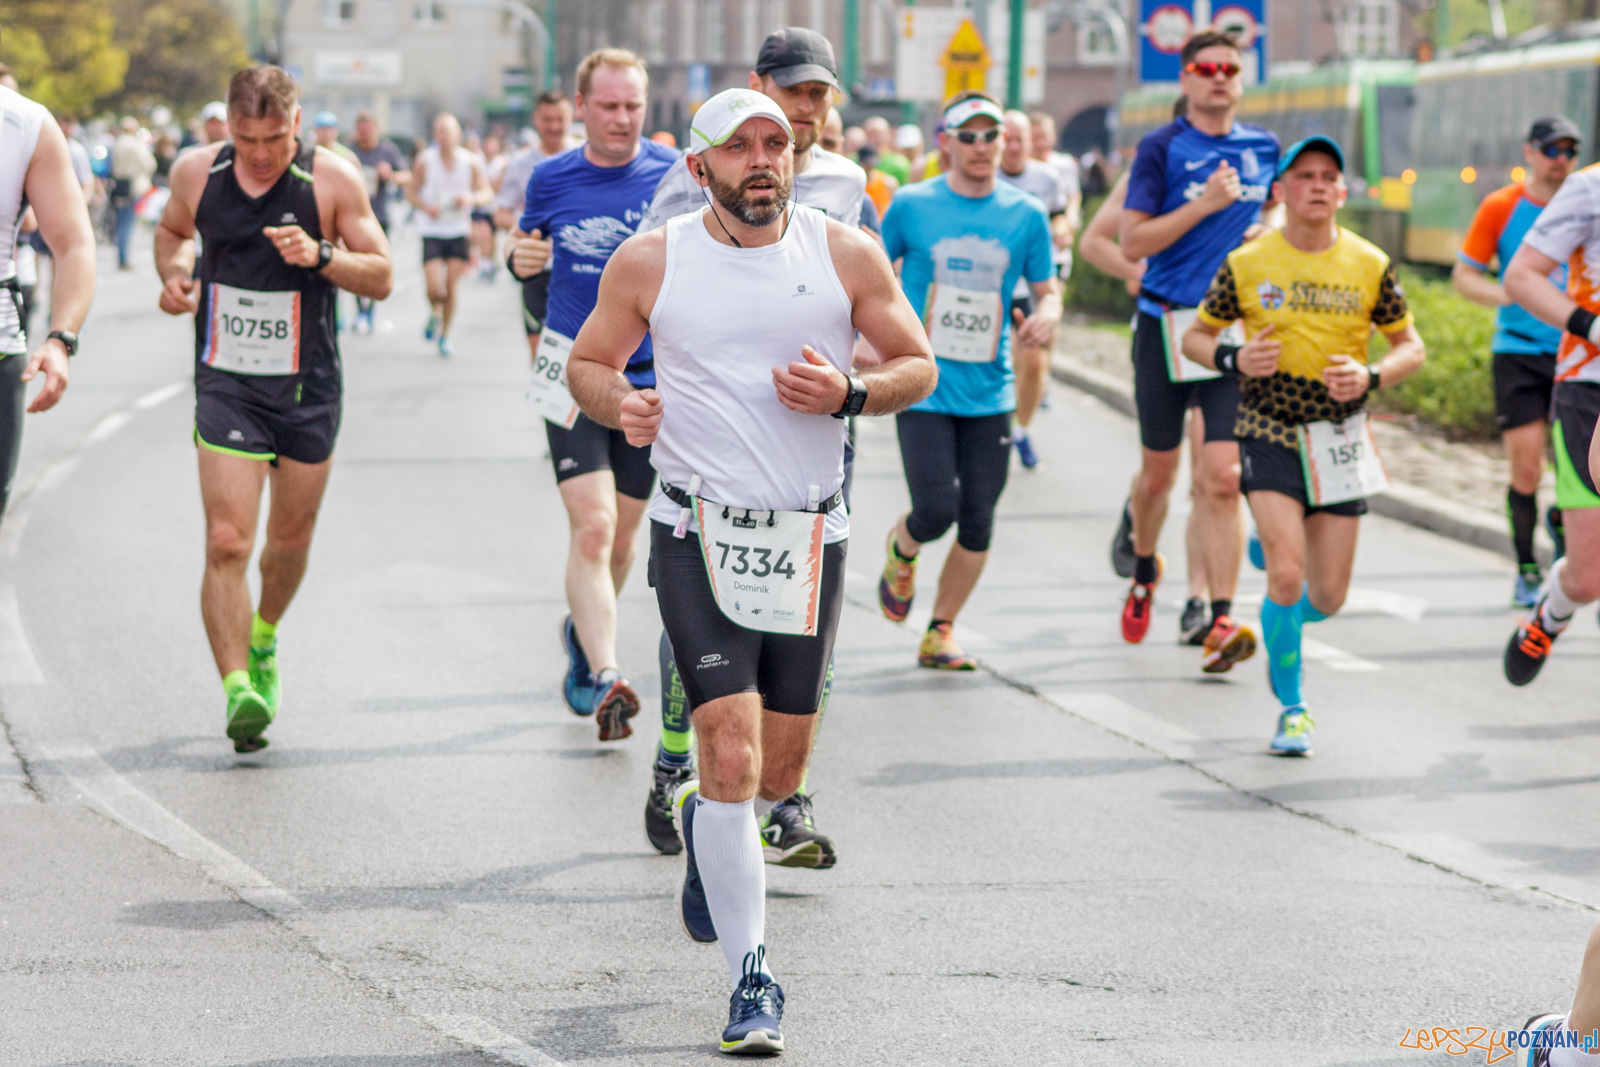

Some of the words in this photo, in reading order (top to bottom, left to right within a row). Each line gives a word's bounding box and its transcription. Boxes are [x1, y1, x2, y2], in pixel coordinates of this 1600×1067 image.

[222, 314, 289, 340] 10758
[941, 311, 991, 332] 6520
[716, 541, 796, 579] 7334
[734, 581, 770, 594] Dominik
